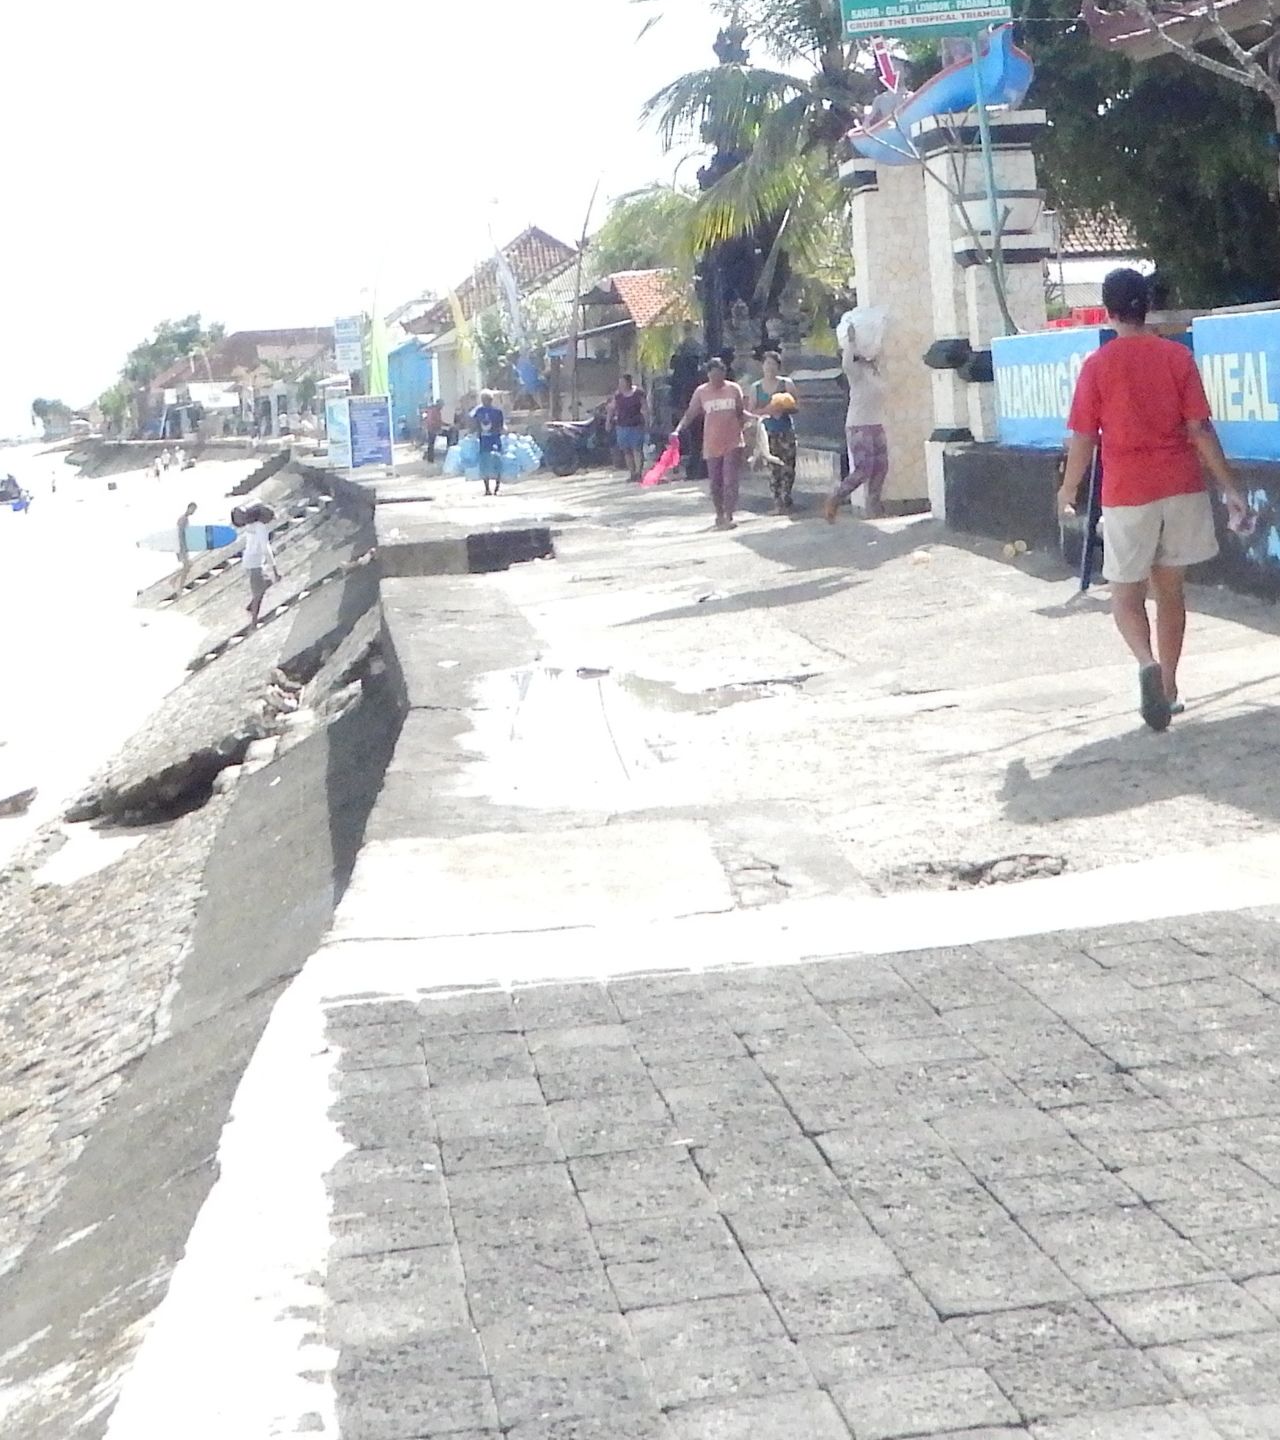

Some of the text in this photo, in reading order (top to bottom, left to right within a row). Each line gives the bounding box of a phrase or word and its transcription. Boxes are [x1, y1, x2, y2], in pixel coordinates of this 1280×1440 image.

[849, 20, 884, 30] CRUISE
[887, 17, 907, 27] THE
[910, 13, 956, 24] TROPICAL
[996, 361, 1069, 419] WARUNG
[1203, 351, 1279, 422] MEAL
